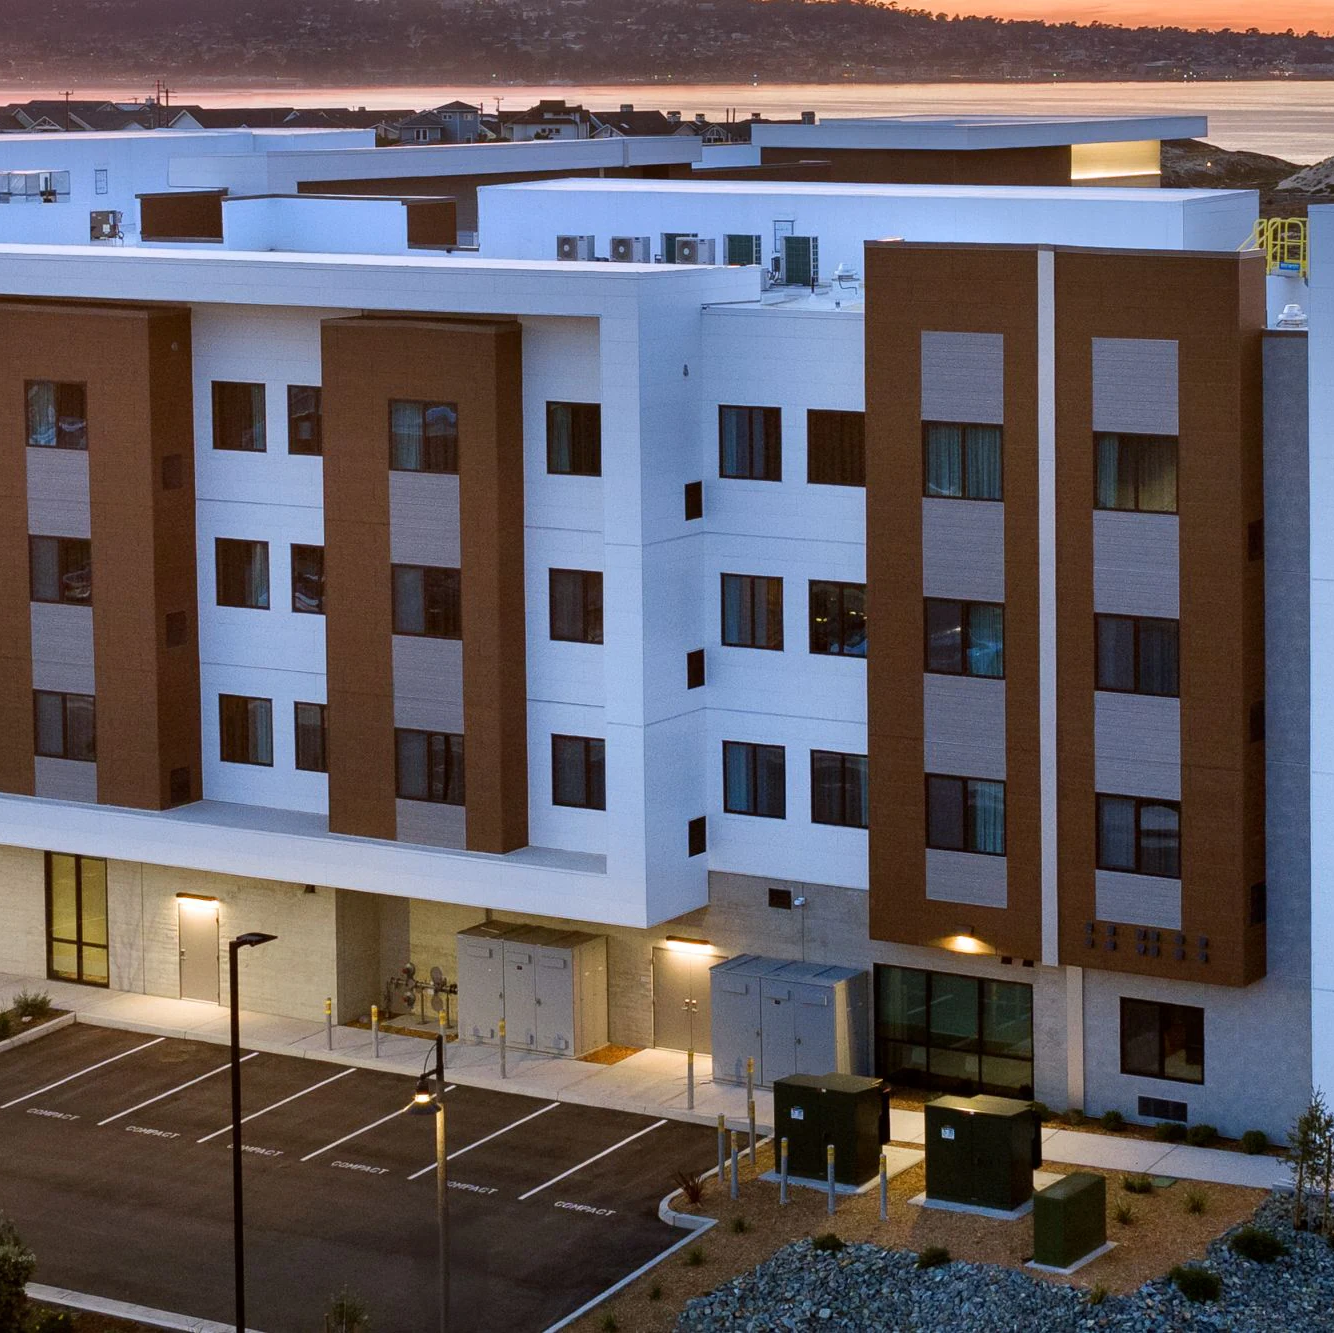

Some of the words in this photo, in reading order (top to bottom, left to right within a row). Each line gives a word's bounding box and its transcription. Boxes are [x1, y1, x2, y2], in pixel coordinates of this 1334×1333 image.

[26, 1107, 81, 1121] COMPACT
[125, 1125, 181, 1140] COMPACT
[227, 1143, 284, 1157] CMPACT
[330, 1160, 390, 1175] COMPACT
[446, 1180, 499, 1195] OMPACT
[554, 1200, 617, 1217] COMPACT
